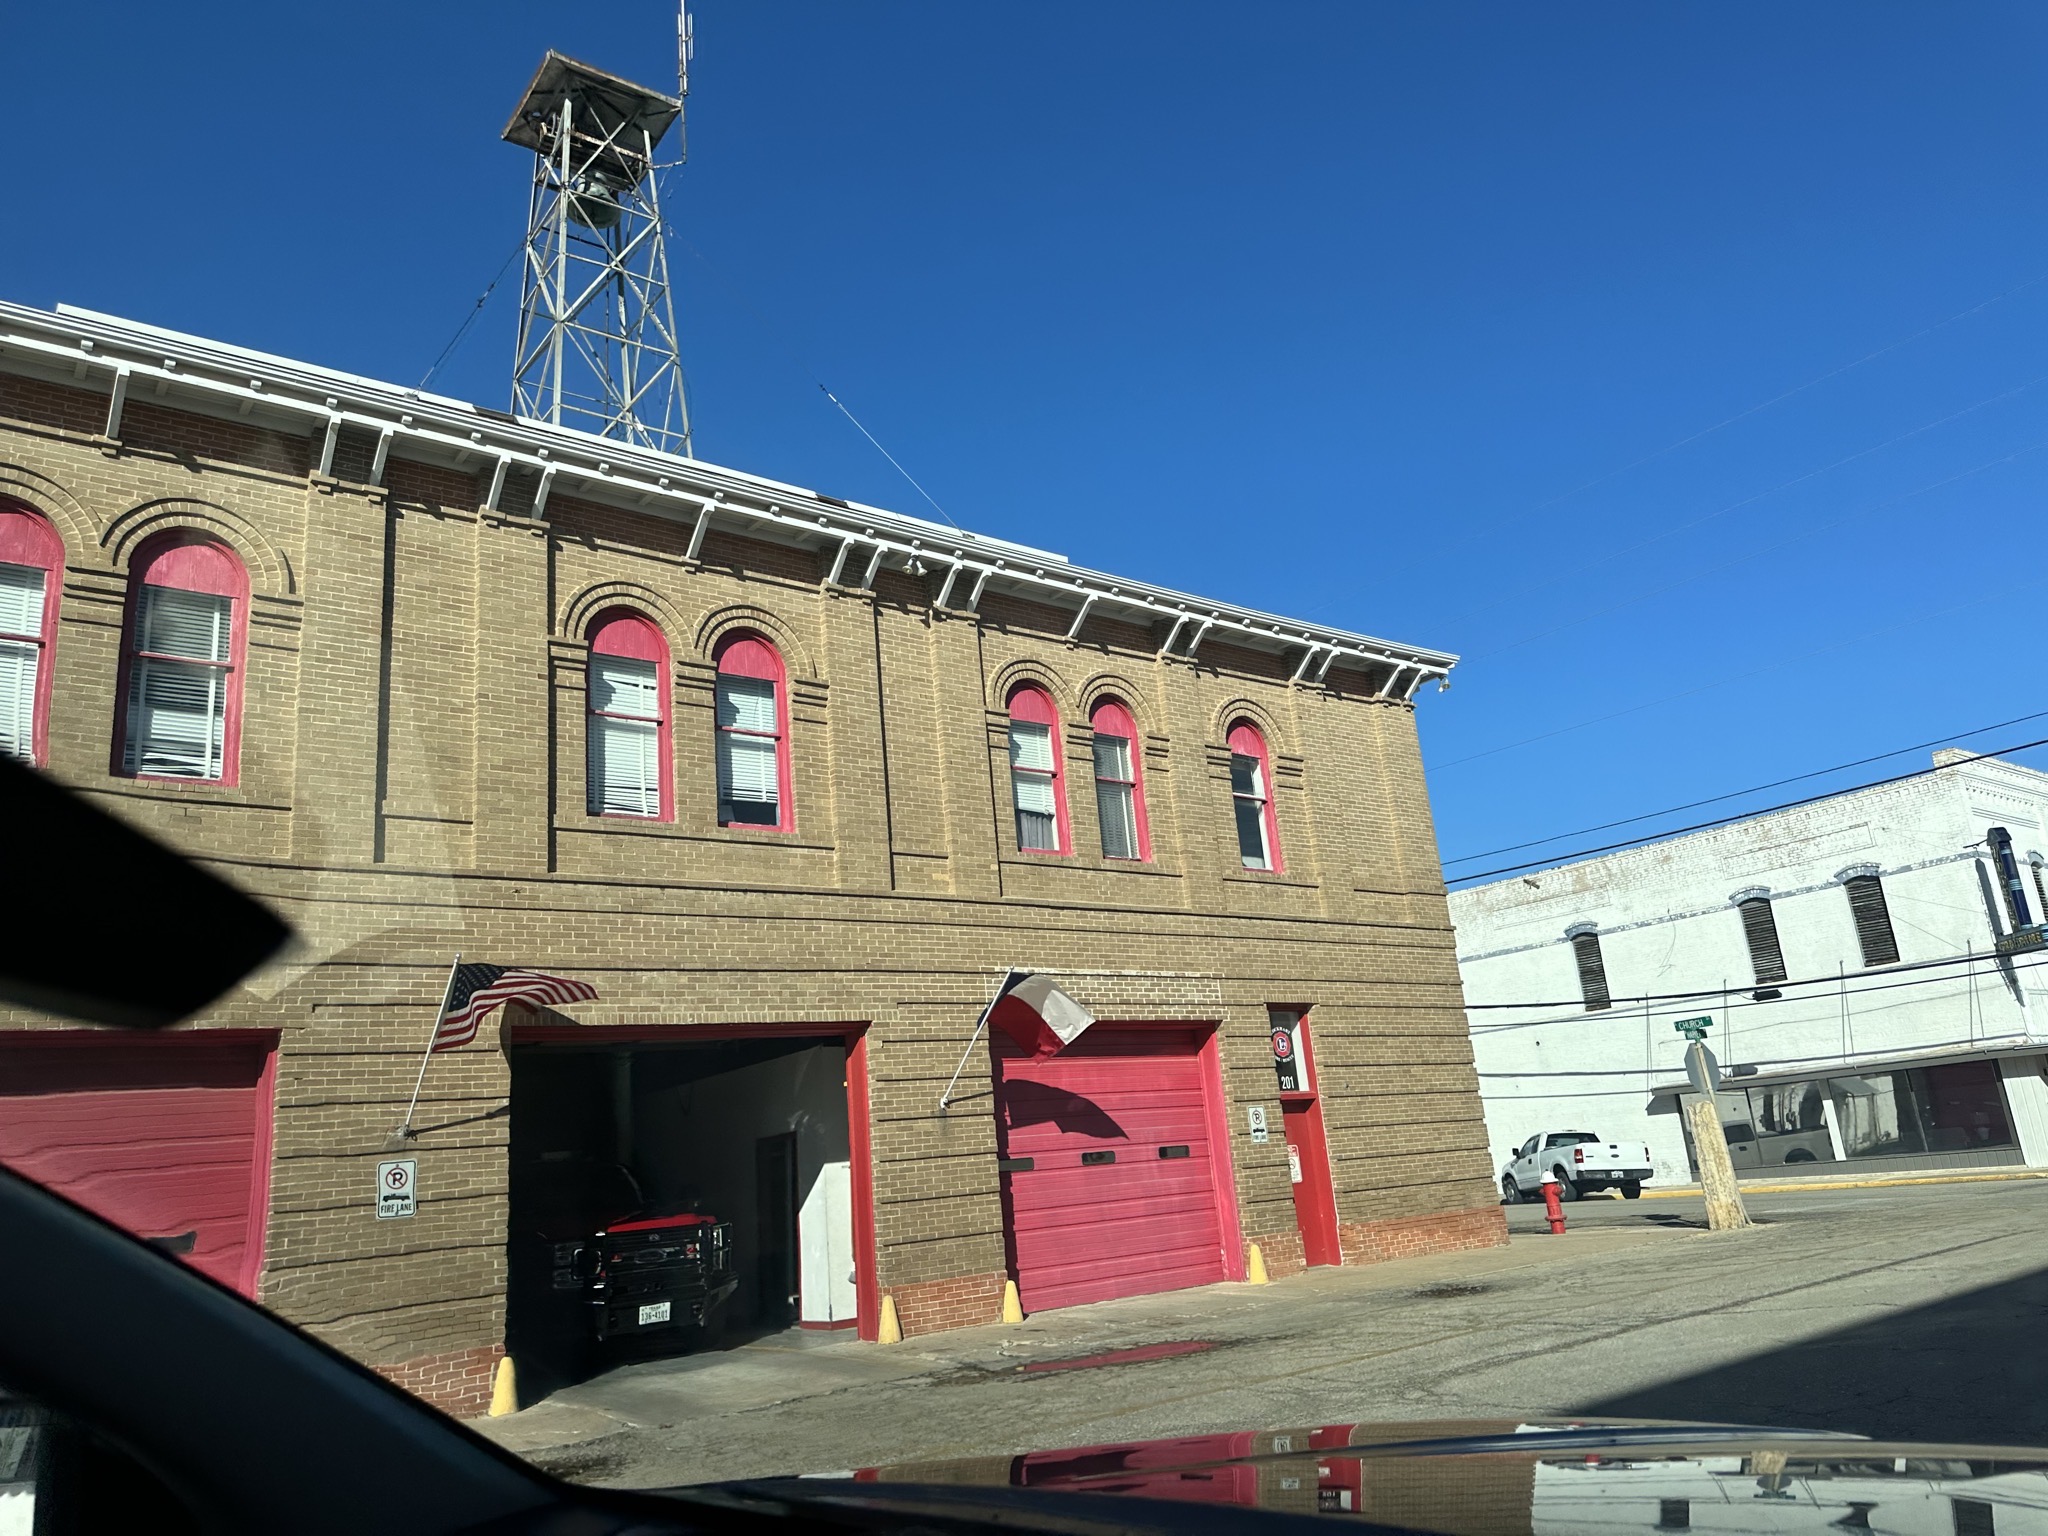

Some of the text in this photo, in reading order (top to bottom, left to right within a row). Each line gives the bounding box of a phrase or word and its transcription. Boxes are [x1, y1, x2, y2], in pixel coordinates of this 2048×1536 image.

[1678, 1018, 1704, 1030] CHURCH
[1281, 1076, 1295, 1089] 201
[381, 1202, 413, 1214] FIRE LANE
